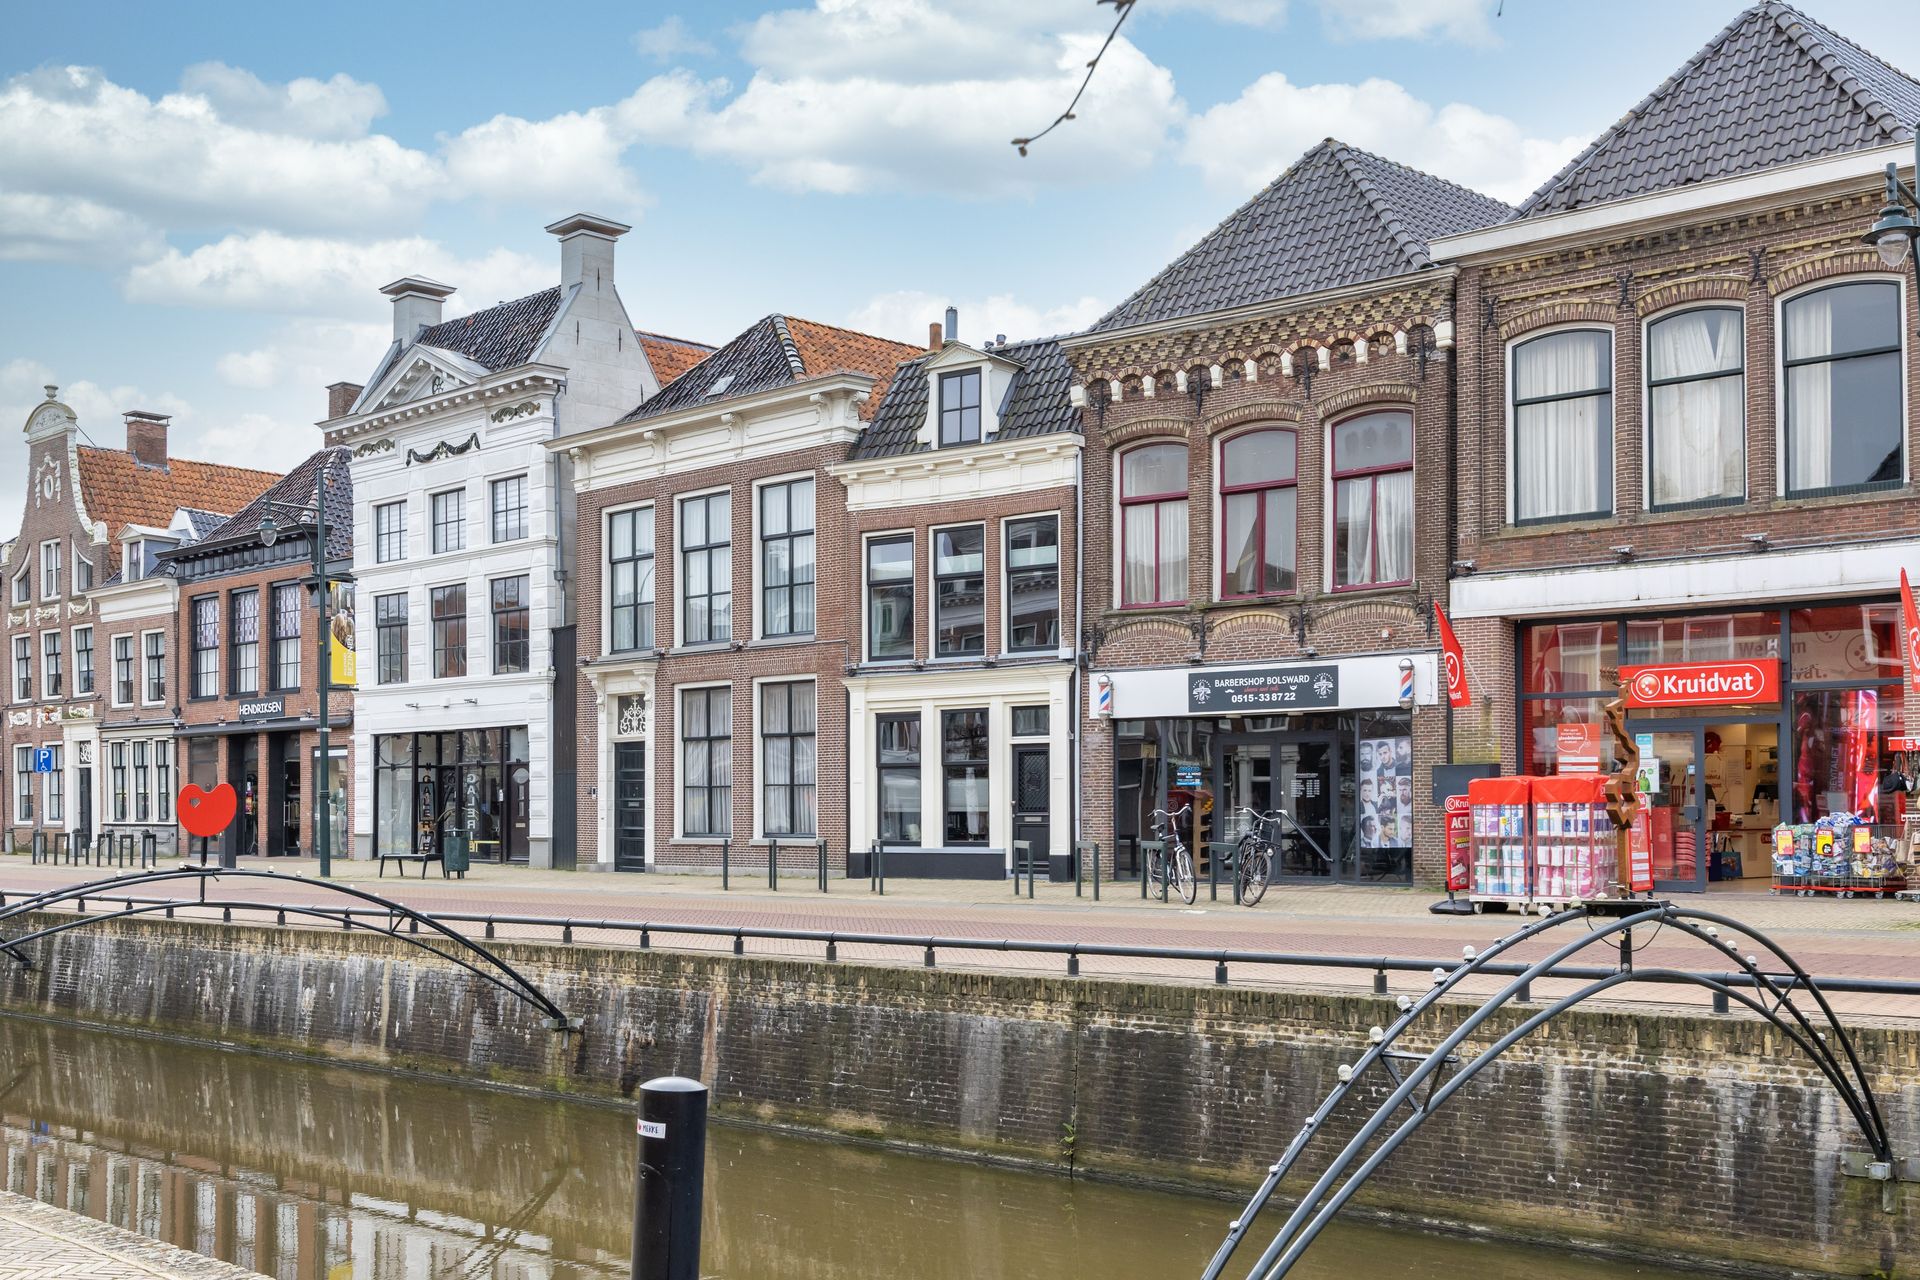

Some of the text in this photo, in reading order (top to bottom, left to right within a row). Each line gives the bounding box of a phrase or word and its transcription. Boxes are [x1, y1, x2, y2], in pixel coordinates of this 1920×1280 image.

[1214, 674, 1310, 688] BARBERSHOP BOLSWARD
[1663, 672, 1754, 694] Kruidvat
[240, 701, 282, 715] HENDRIKSEN
[40, 750, 49, 763] P
